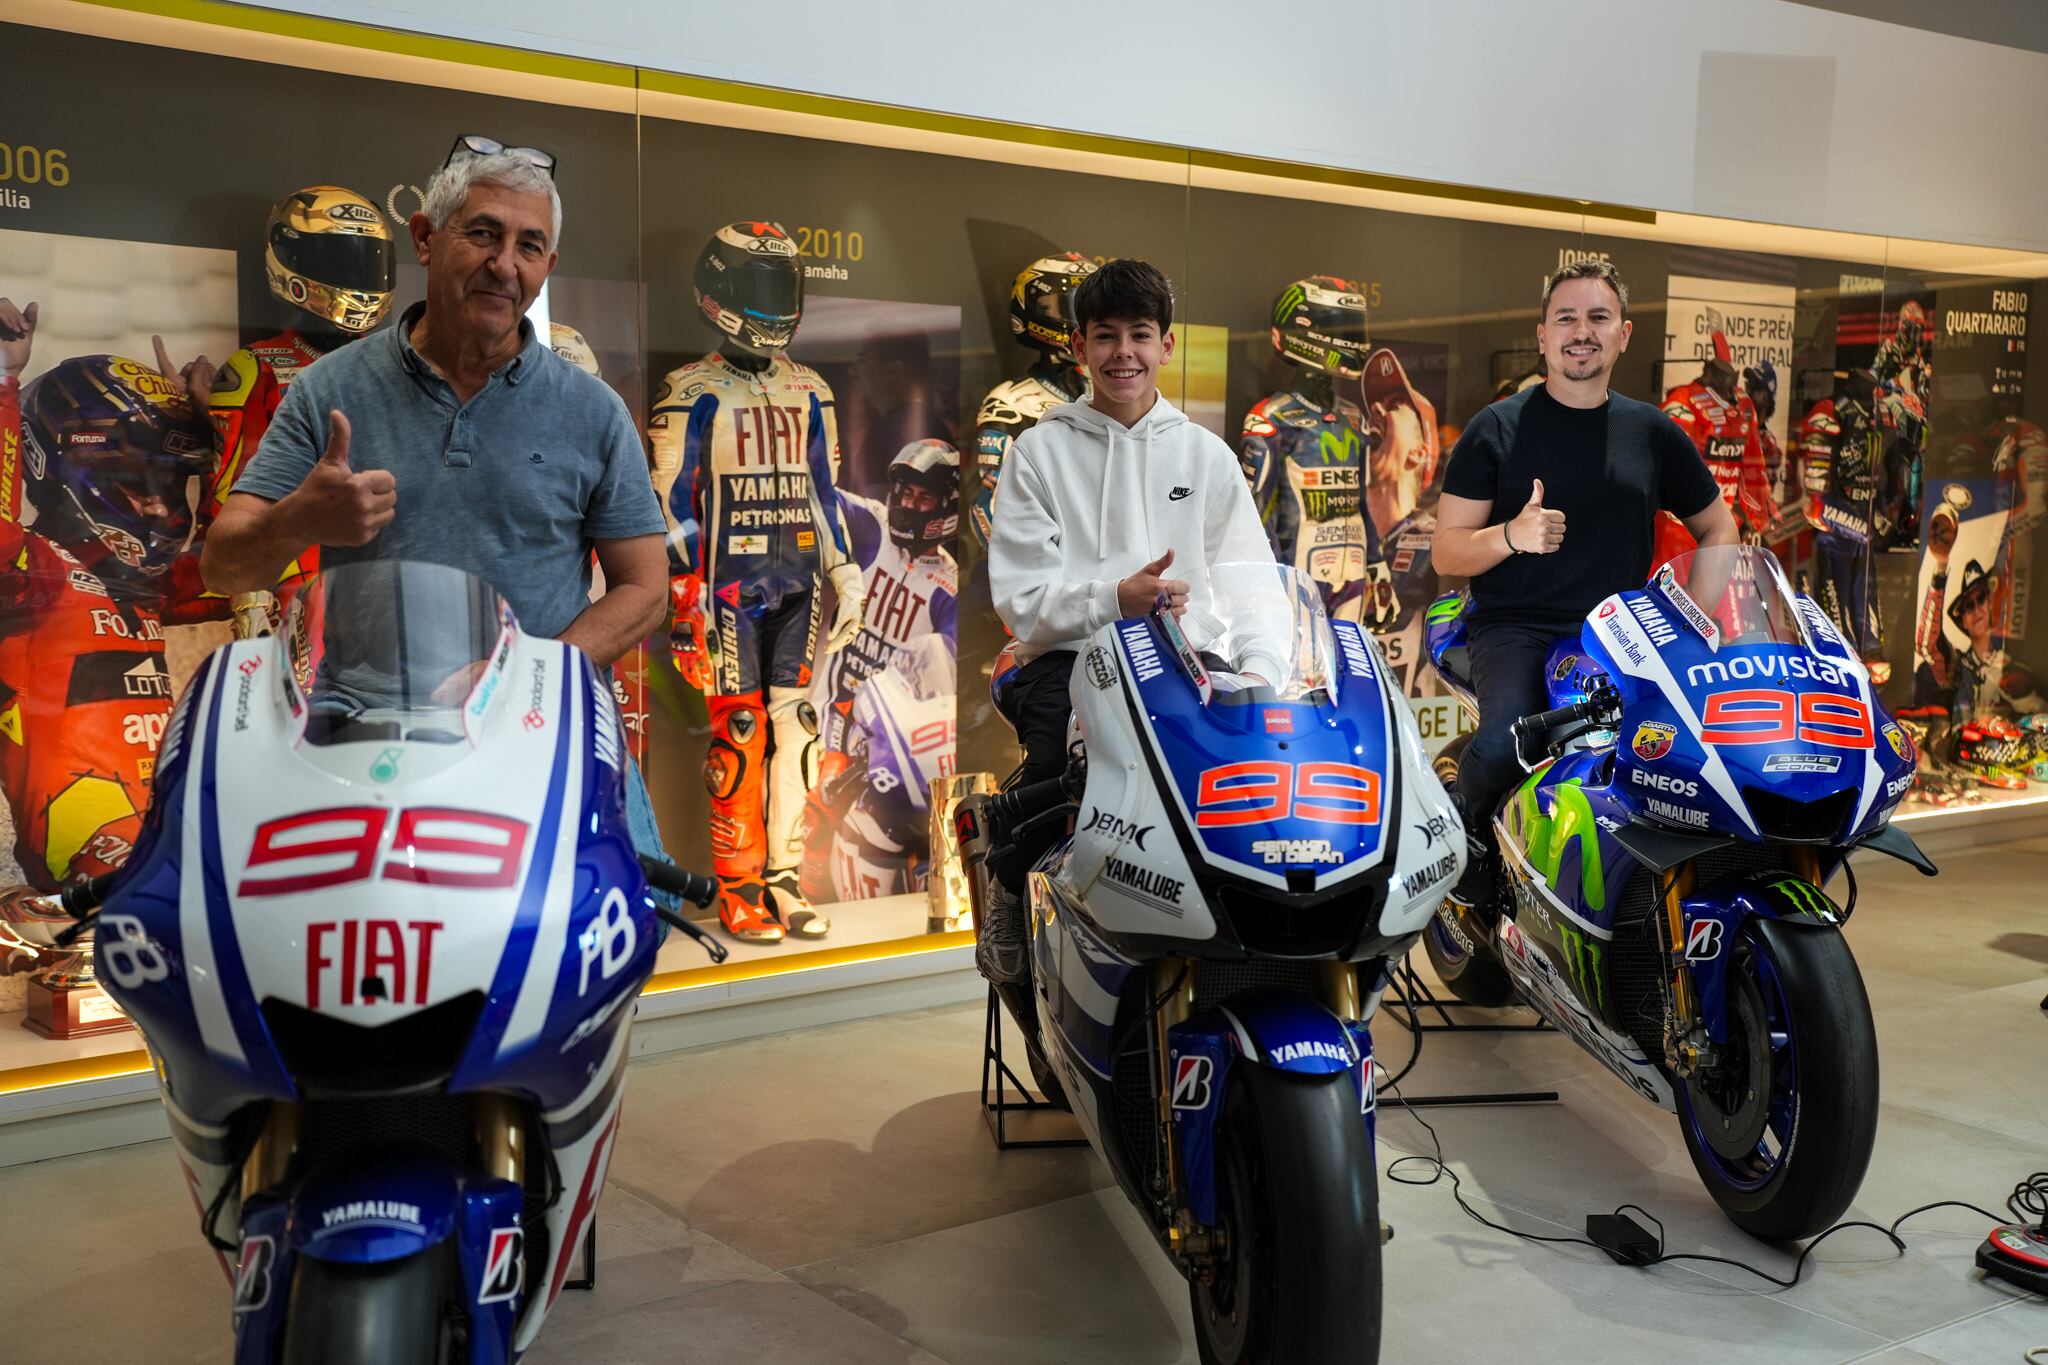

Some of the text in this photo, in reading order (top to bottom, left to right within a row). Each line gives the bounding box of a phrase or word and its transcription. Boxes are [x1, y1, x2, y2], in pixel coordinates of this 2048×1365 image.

[797, 226, 864, 261] 2010
[804, 264, 848, 280] amaha
[1992, 289, 2028, 313] FABIO
[1946, 310, 2026, 337] QUARTARARO
[71, 434, 107, 444] Fortuna
[733, 406, 802, 467] FIAT
[729, 476, 808, 502] YAMAHA
[1172, 486, 1190, 496] NIKE
[730, 507, 812, 527] PETRONAS
[1822, 503, 1868, 535] YAMAHA
[864, 566, 927, 643] FIAT
[1626, 595, 1678, 648] YAMAHA
[720, 606, 741, 695] DAINESE
[1121, 622, 1164, 683] YAMAHA
[1333, 625, 1375, 680] YAMAHA
[1606, 614, 1647, 668] Eurasian Bank
[123, 674, 171, 695] LOTU
[1686, 654, 1850, 689] movistar
[1641, 721, 1677, 735] ABARTH
[1700, 688, 1876, 750] 99
[1778, 756, 1832, 764] BLUE
[1195, 760, 1382, 828] 99
[1631, 768, 1699, 798] ENEOS
[1646, 797, 1710, 829] YAMALUBE
[236, 804, 532, 899] 99
[1105, 855, 1186, 905] YAMALUBE
[1402, 852, 1457, 899] YAMALUBE
[305, 919, 445, 1009] FIAT
[1270, 1039, 1351, 1065] YAMAHA
[321, 1200, 421, 1227] YAMALUBE
